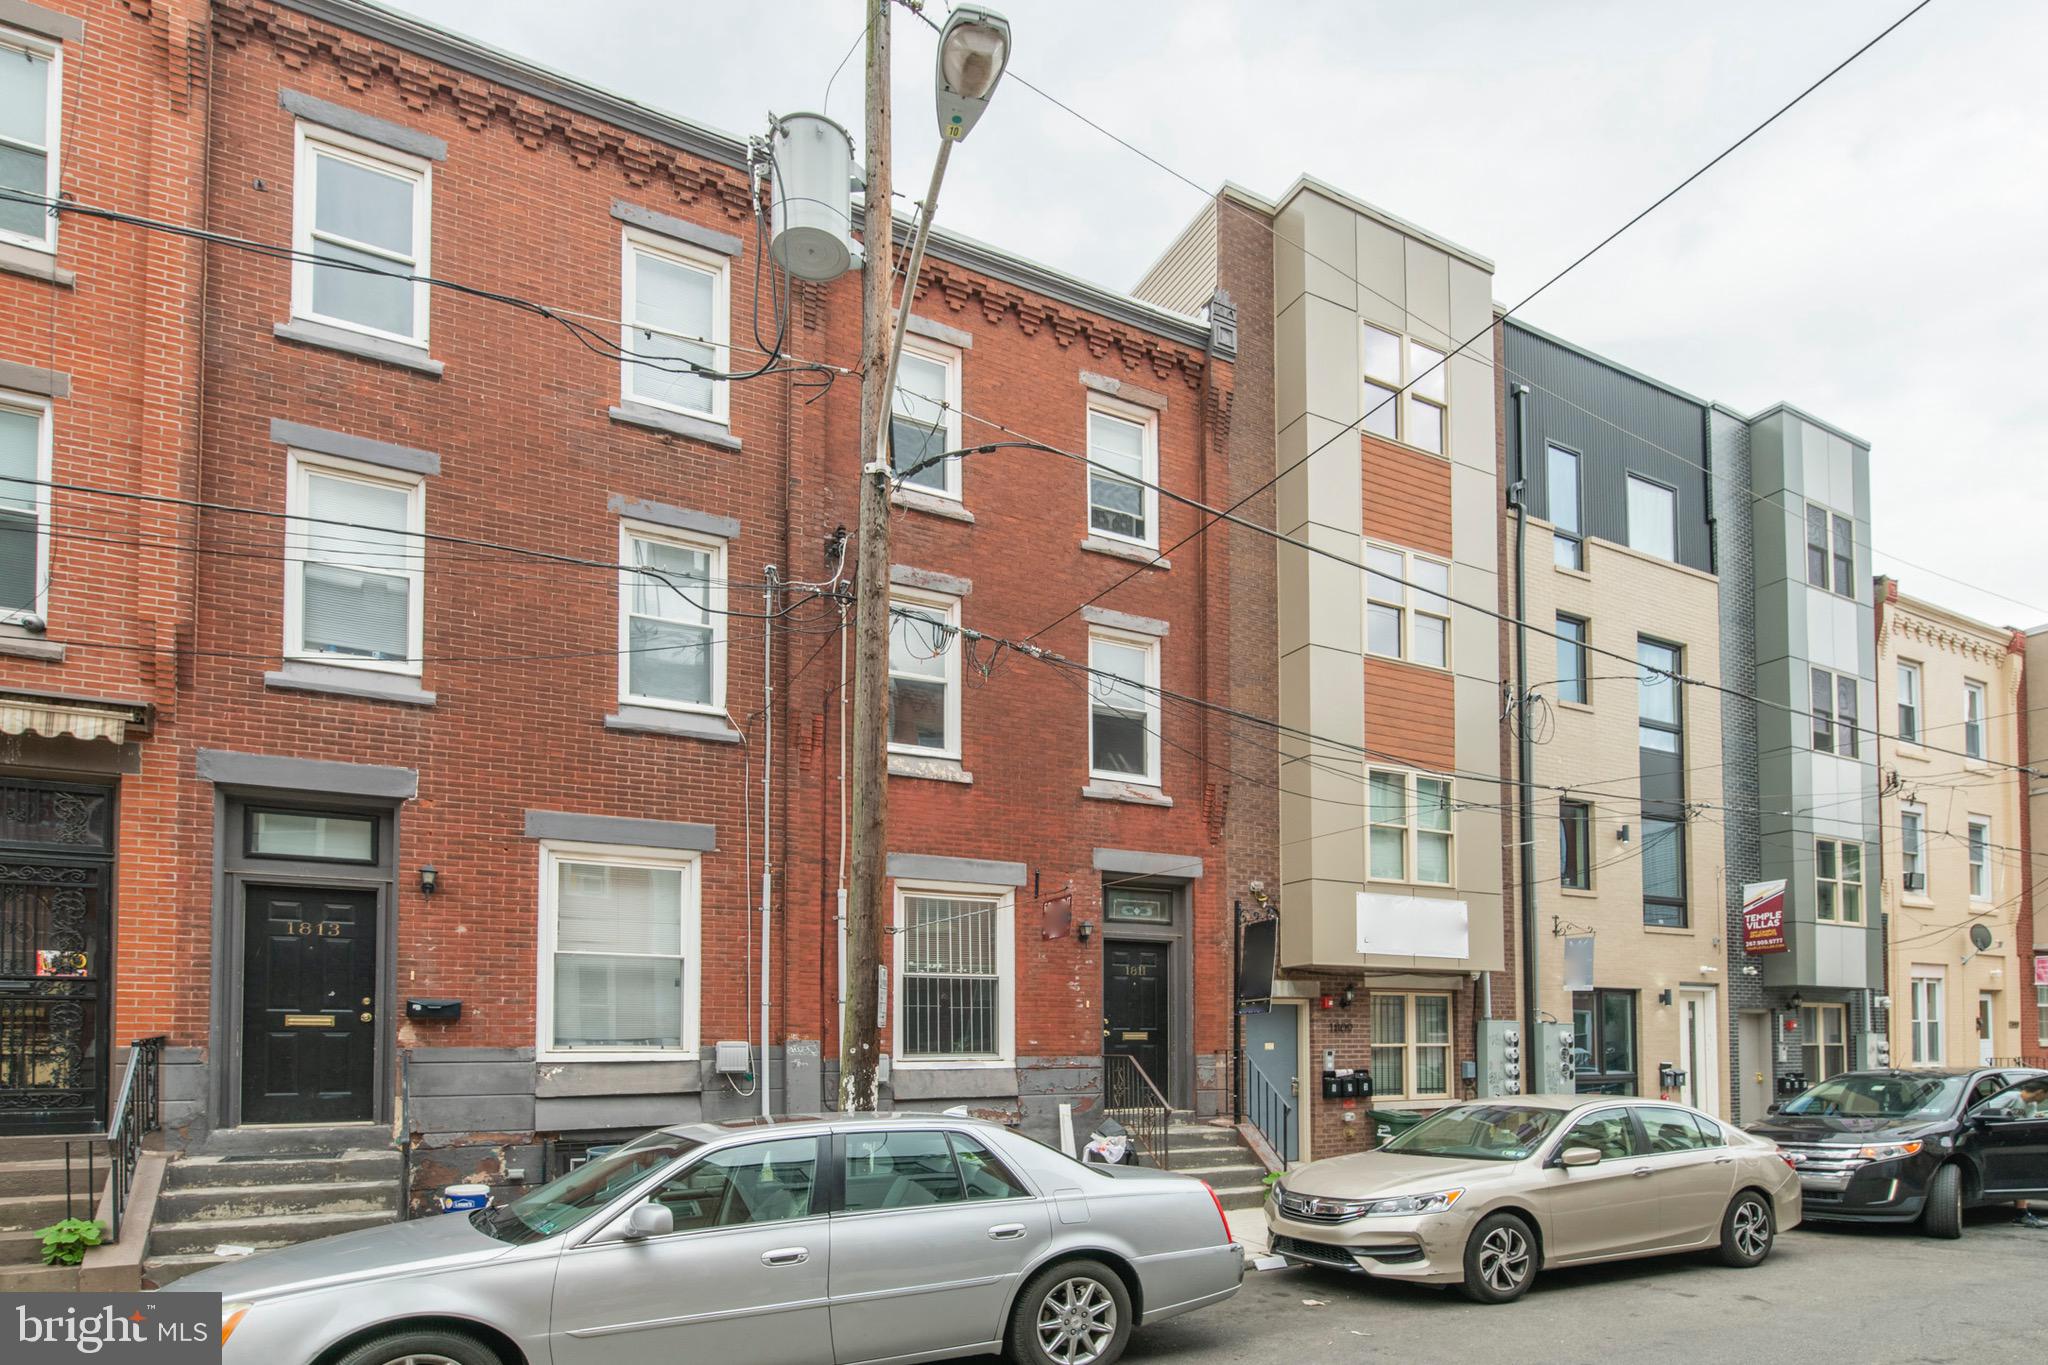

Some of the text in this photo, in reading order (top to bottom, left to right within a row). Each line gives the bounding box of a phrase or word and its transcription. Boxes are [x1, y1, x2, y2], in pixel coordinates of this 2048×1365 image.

[949, 126, 959, 137] 10
[1745, 911, 1782, 922] TEMPLE
[288, 921, 340, 936] 1813
[1746, 919, 1780, 930] VILLAS
[1126, 964, 1146, 976] 1811
